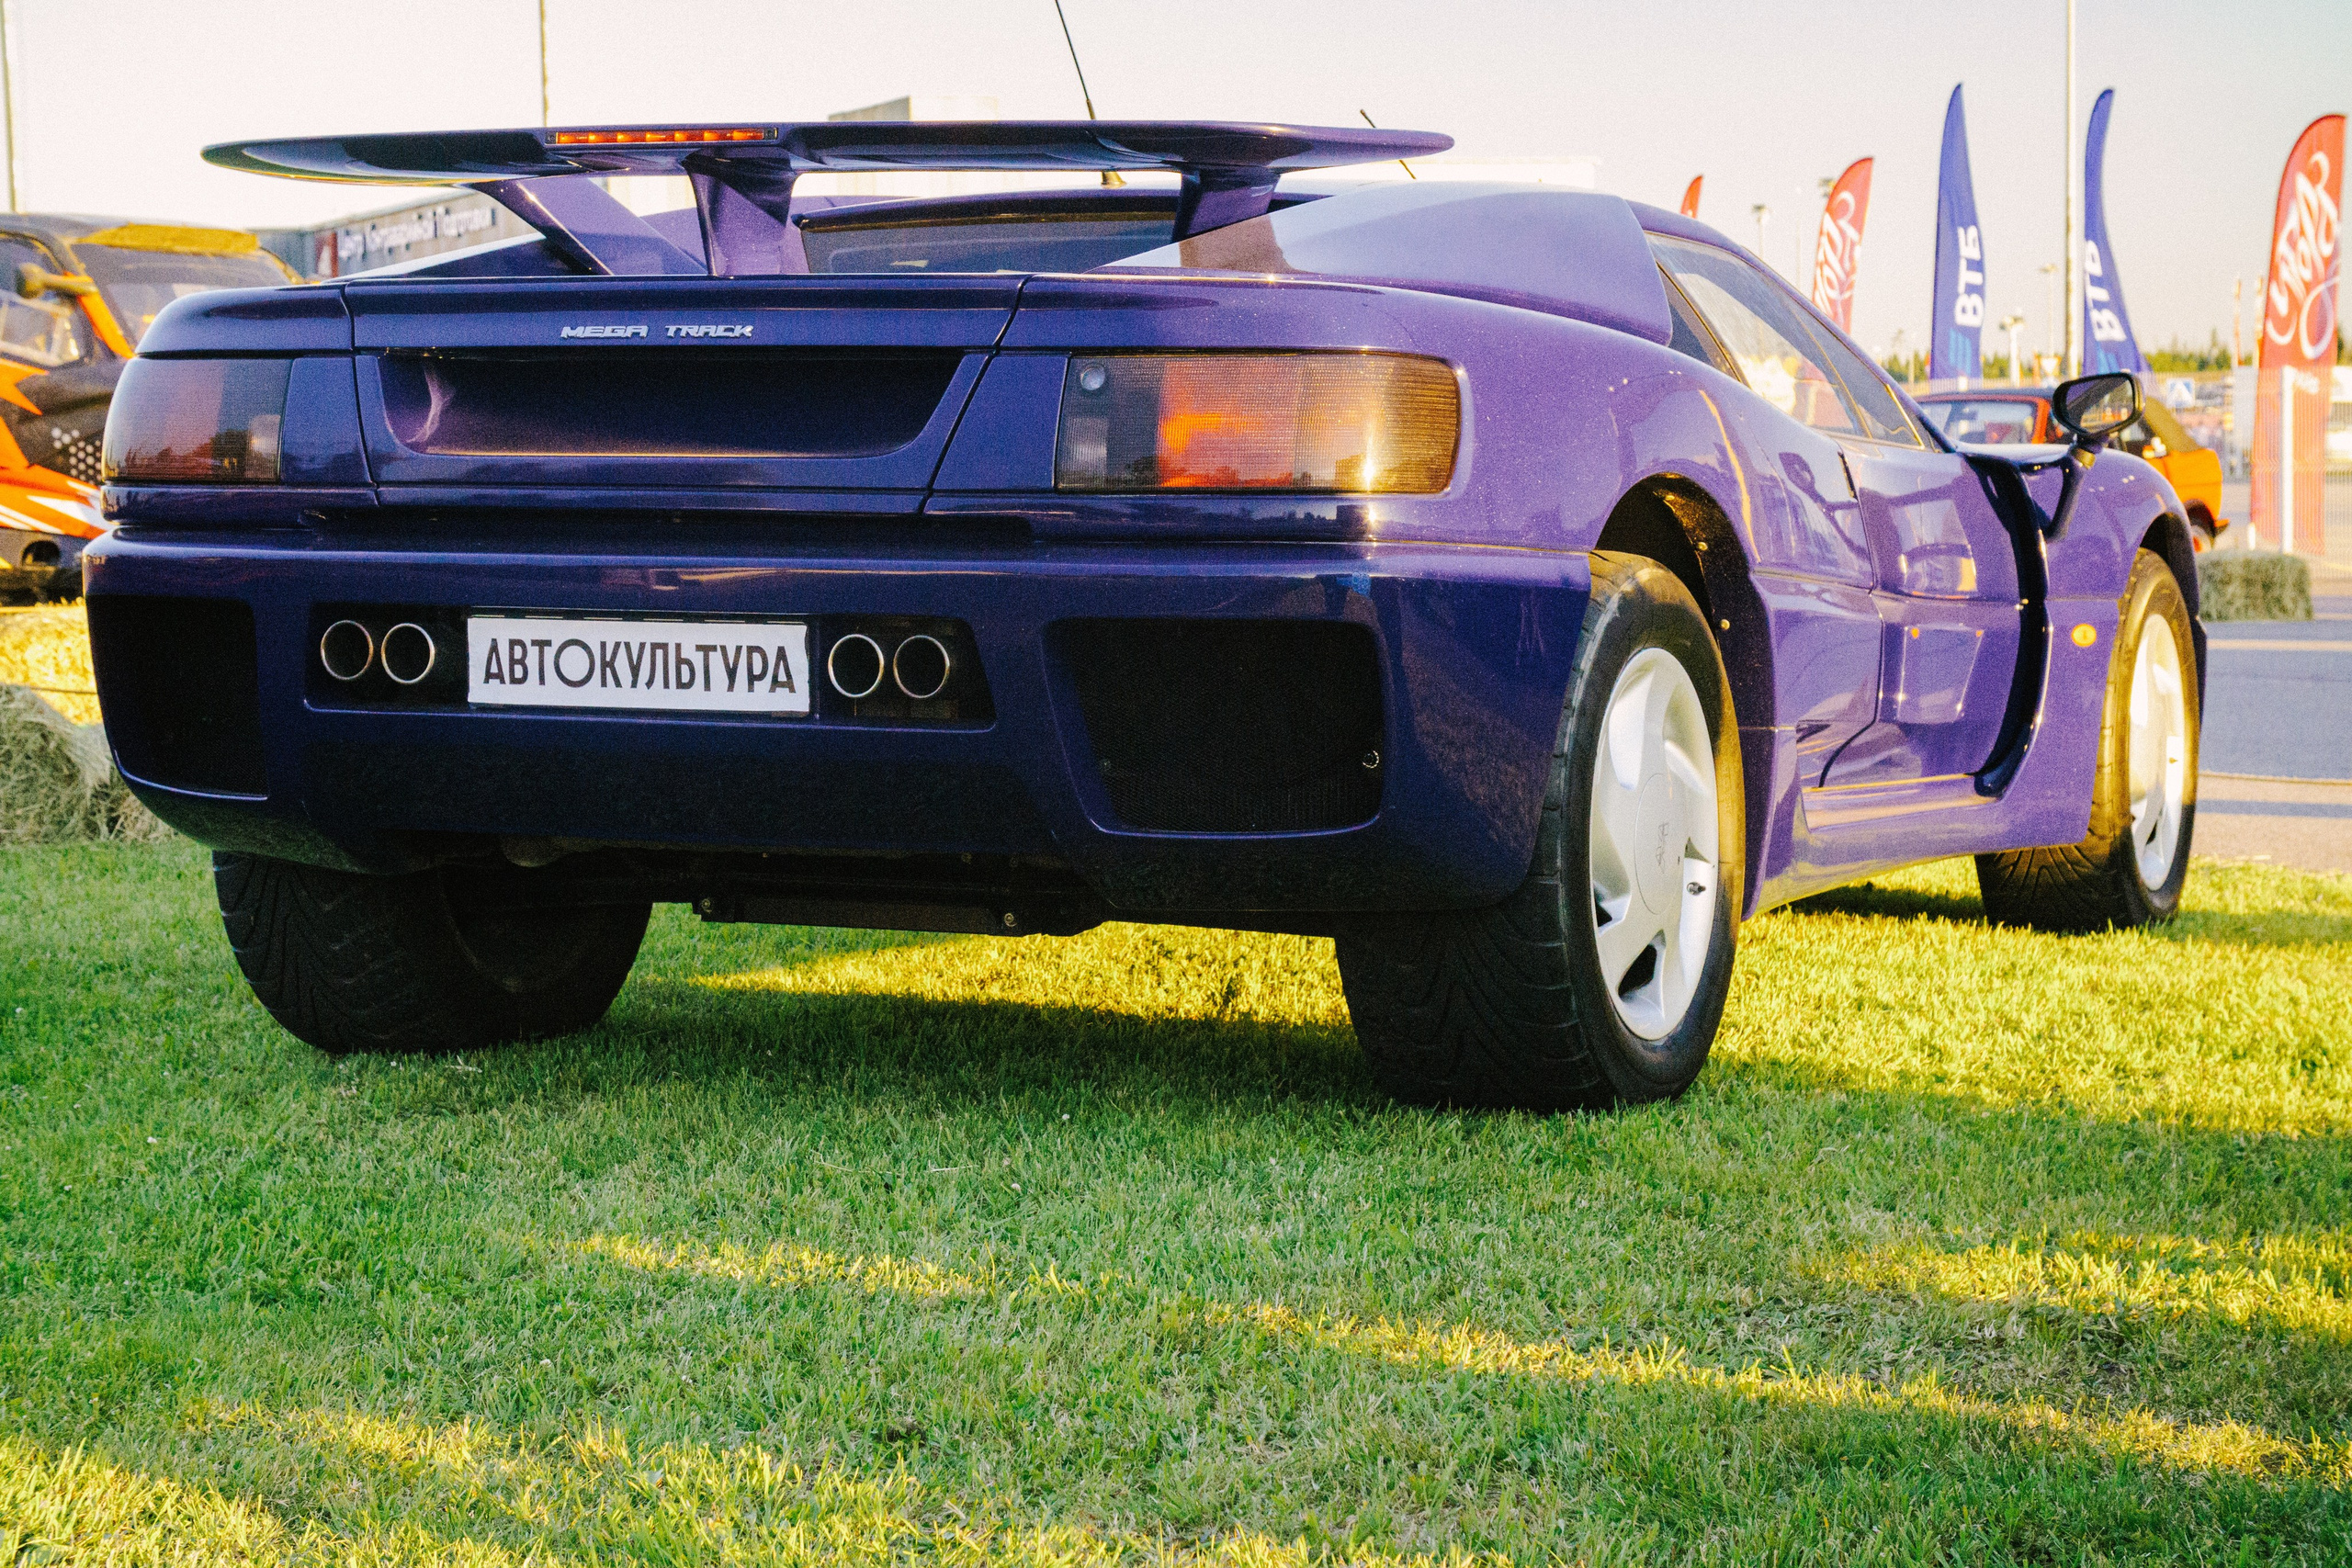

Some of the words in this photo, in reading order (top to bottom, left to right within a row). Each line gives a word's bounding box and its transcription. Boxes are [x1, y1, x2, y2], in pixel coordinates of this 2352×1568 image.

[1954, 224, 1984, 328] ВТБ
[560, 324, 650, 339] MEGA
[664, 324, 754, 338] TRACK
[483, 637, 797, 694] АВТОКУЛЬТУРА
